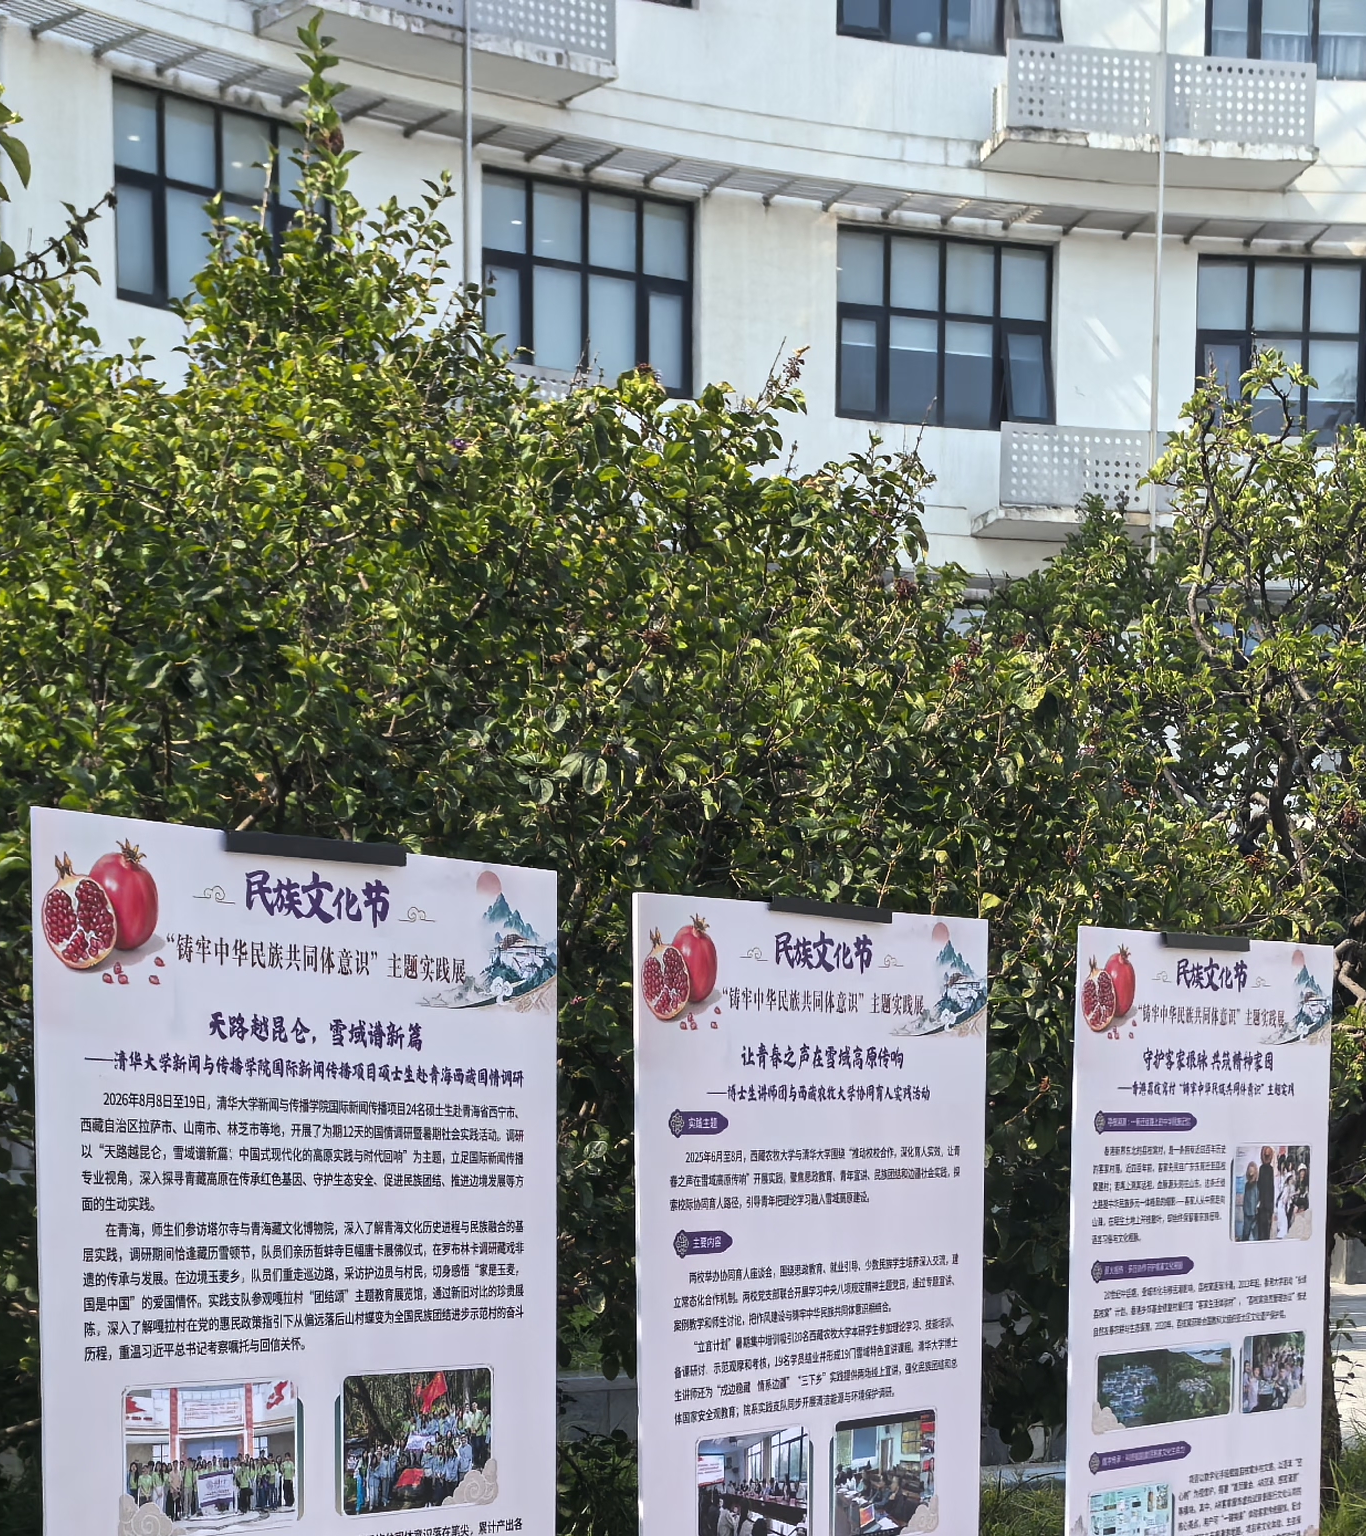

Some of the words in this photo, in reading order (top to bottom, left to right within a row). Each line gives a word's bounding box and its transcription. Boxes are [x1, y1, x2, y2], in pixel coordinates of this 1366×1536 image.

[245, 870, 390, 928] 民族文化节
[166, 934, 466, 984] “铸牢中华民族共同体意识”主题实践展
[775, 930, 872, 974] 民族文化节
[1176, 957, 1247, 992] 民族文化节
[210, 1012, 423, 1052] 天路越昆仑，雪域谱新篇
[741, 1042, 904, 1070] 让青春之声在雪域高原传响
[81, 1196, 155, 1214] 面的生动实践。
